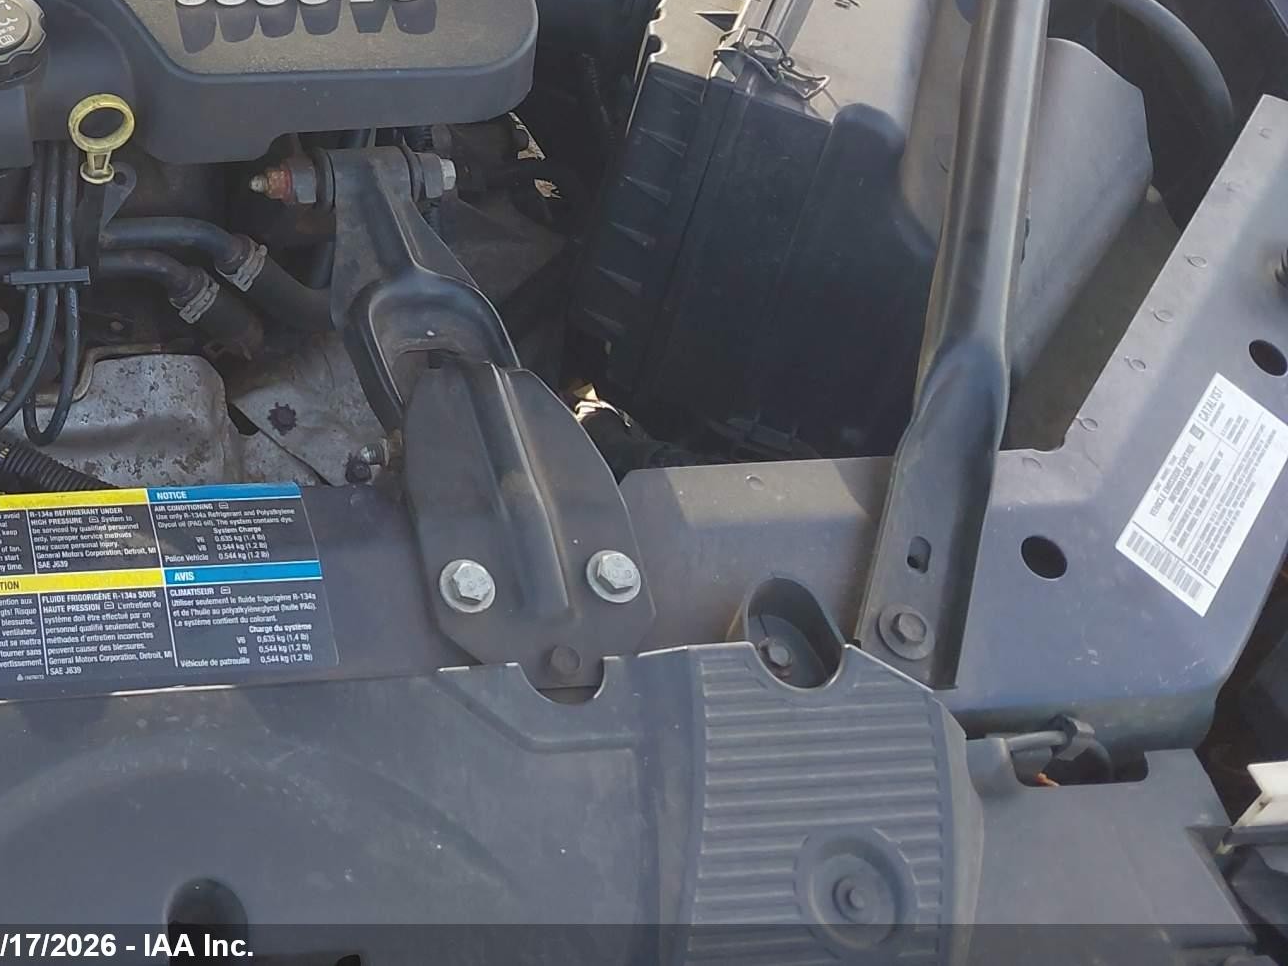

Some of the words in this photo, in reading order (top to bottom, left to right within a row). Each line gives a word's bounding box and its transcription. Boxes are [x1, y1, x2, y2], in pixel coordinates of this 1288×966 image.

[156, 491, 187, 500] NOTICE
[173, 572, 194, 581] AVIS
[137, 590, 156, 598] SOUS
[169, 587, 214, 596] CLIMATISEUR
[42, 604, 65, 613] HAUTE
[66, 603, 100, 612] PRESSION
